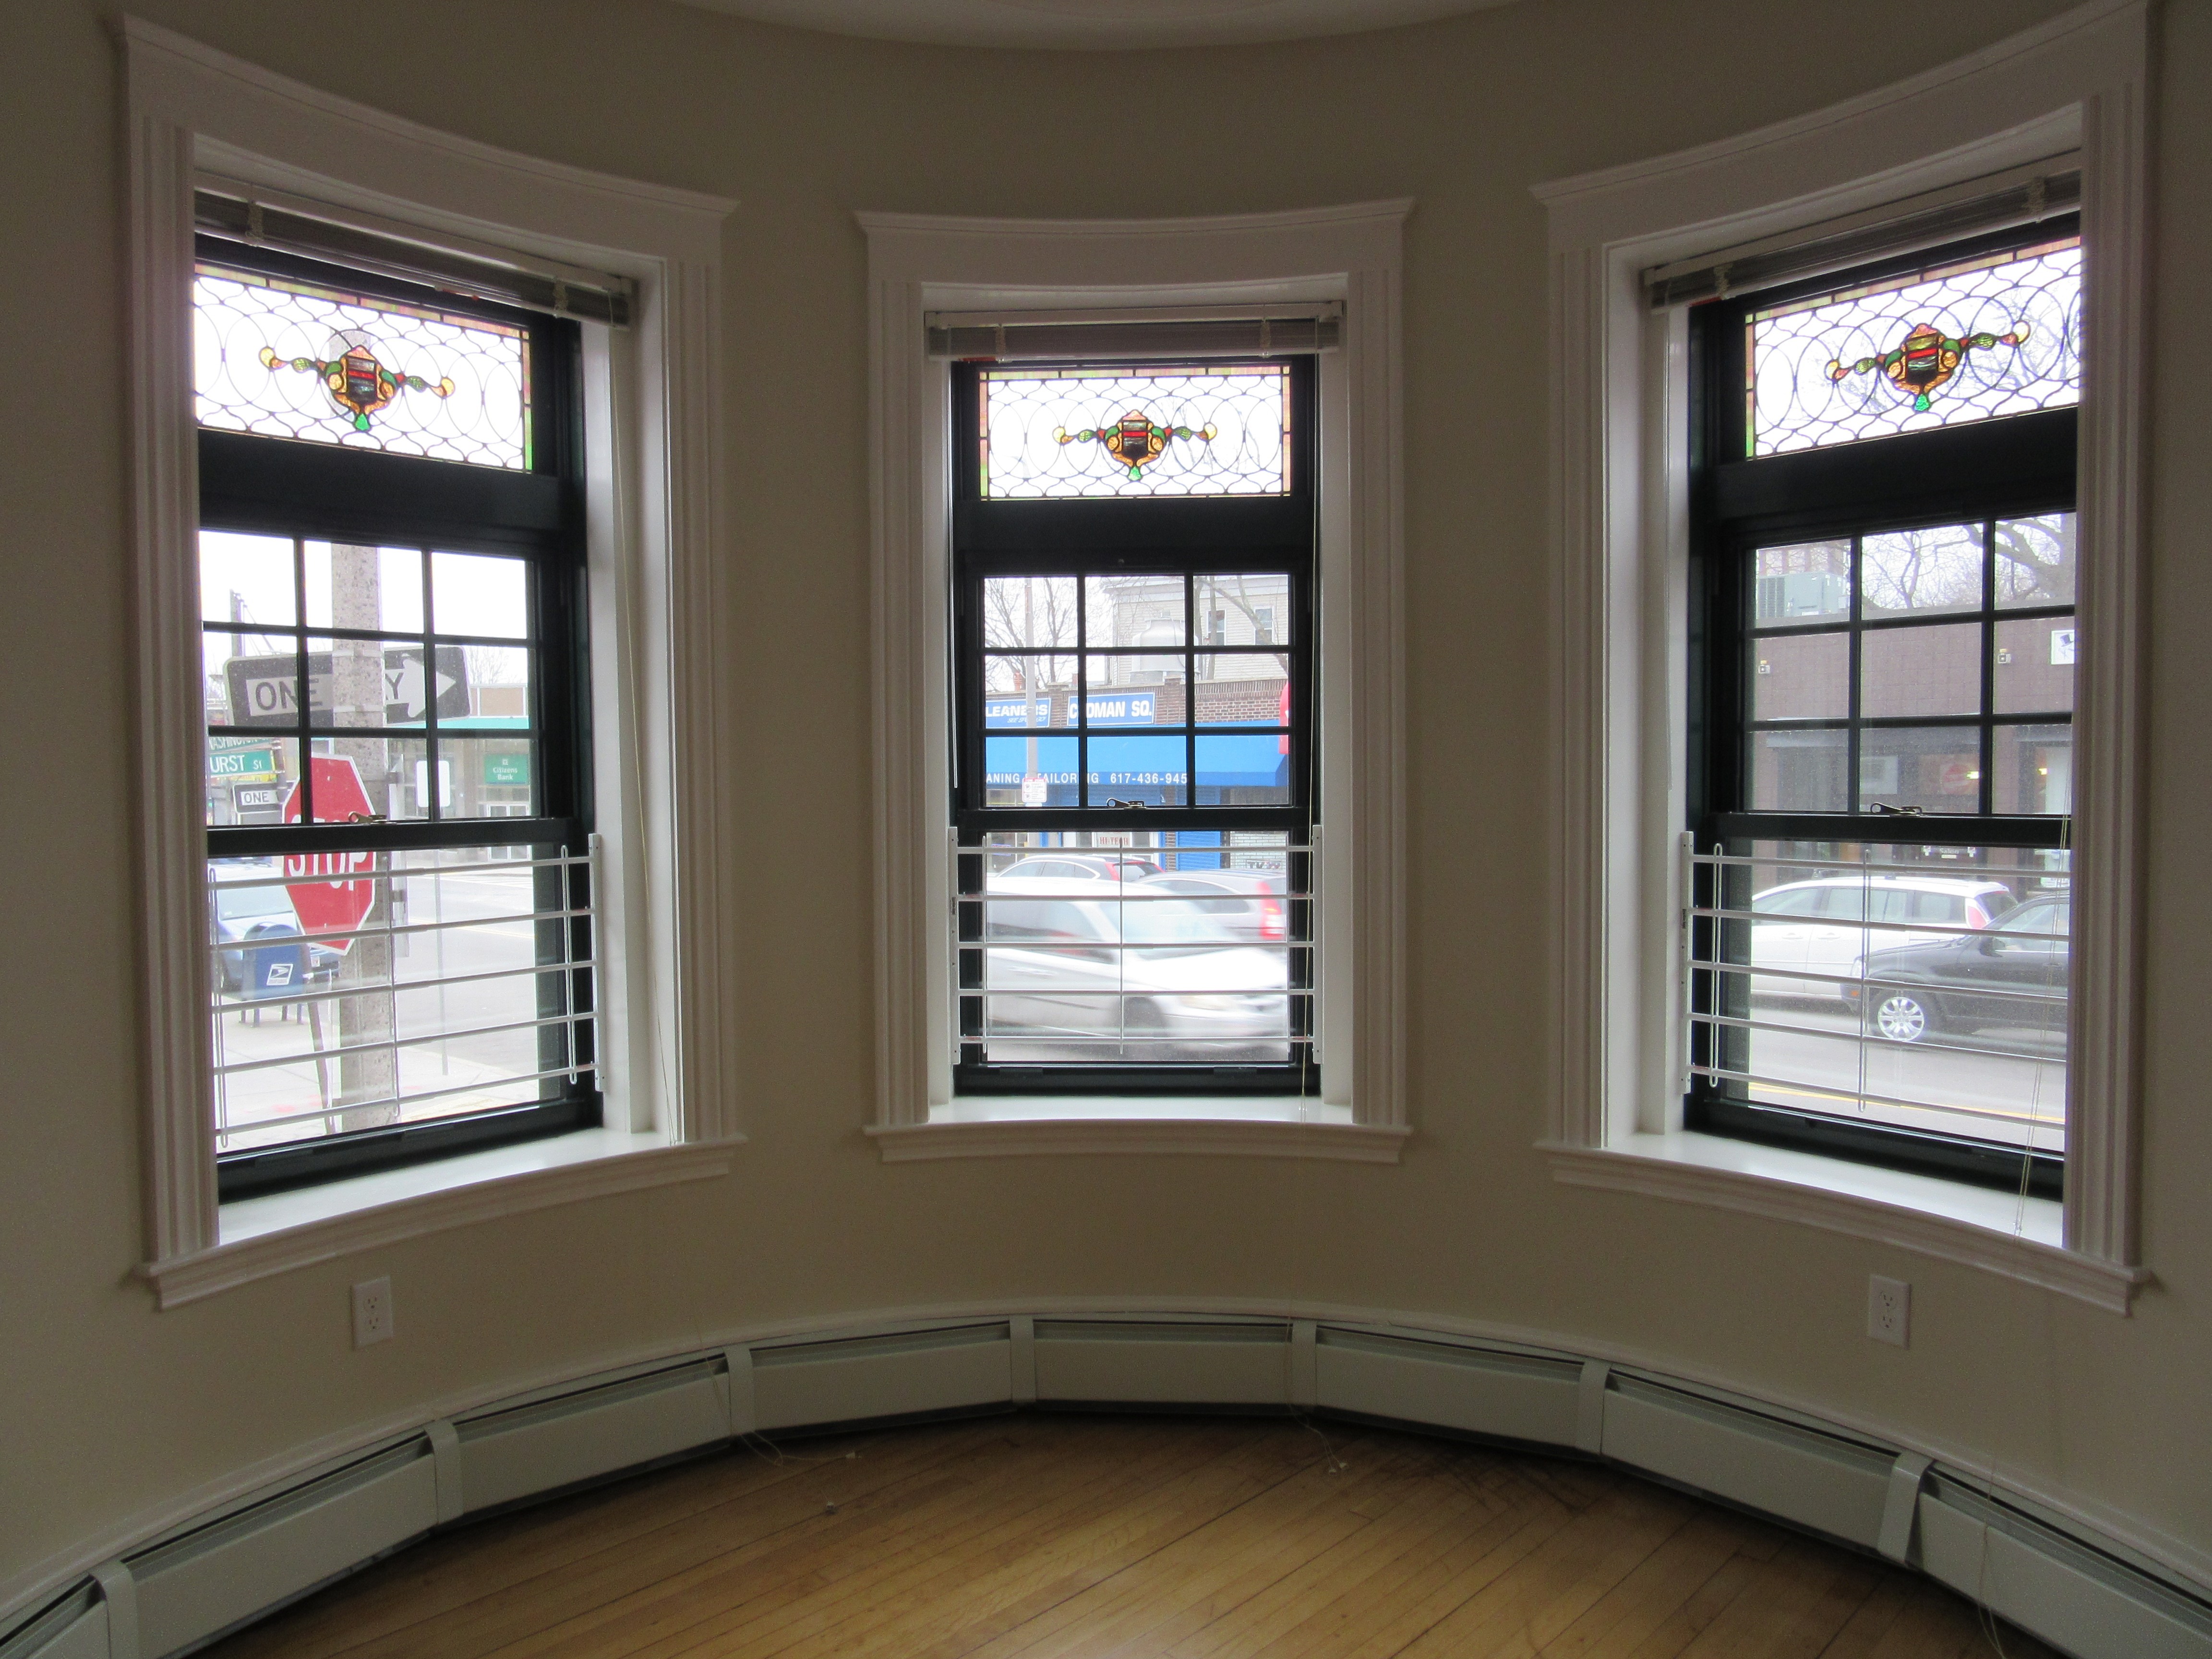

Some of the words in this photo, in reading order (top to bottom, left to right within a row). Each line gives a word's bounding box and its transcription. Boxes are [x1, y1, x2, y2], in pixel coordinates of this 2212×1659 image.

[256, 678, 323, 710] ONE
[986, 704, 1048, 717] LEANES
[1069, 701, 1126, 719] CDMAN
[1131, 700, 1152, 717] SQ.
[244, 792, 269, 804] ONE
